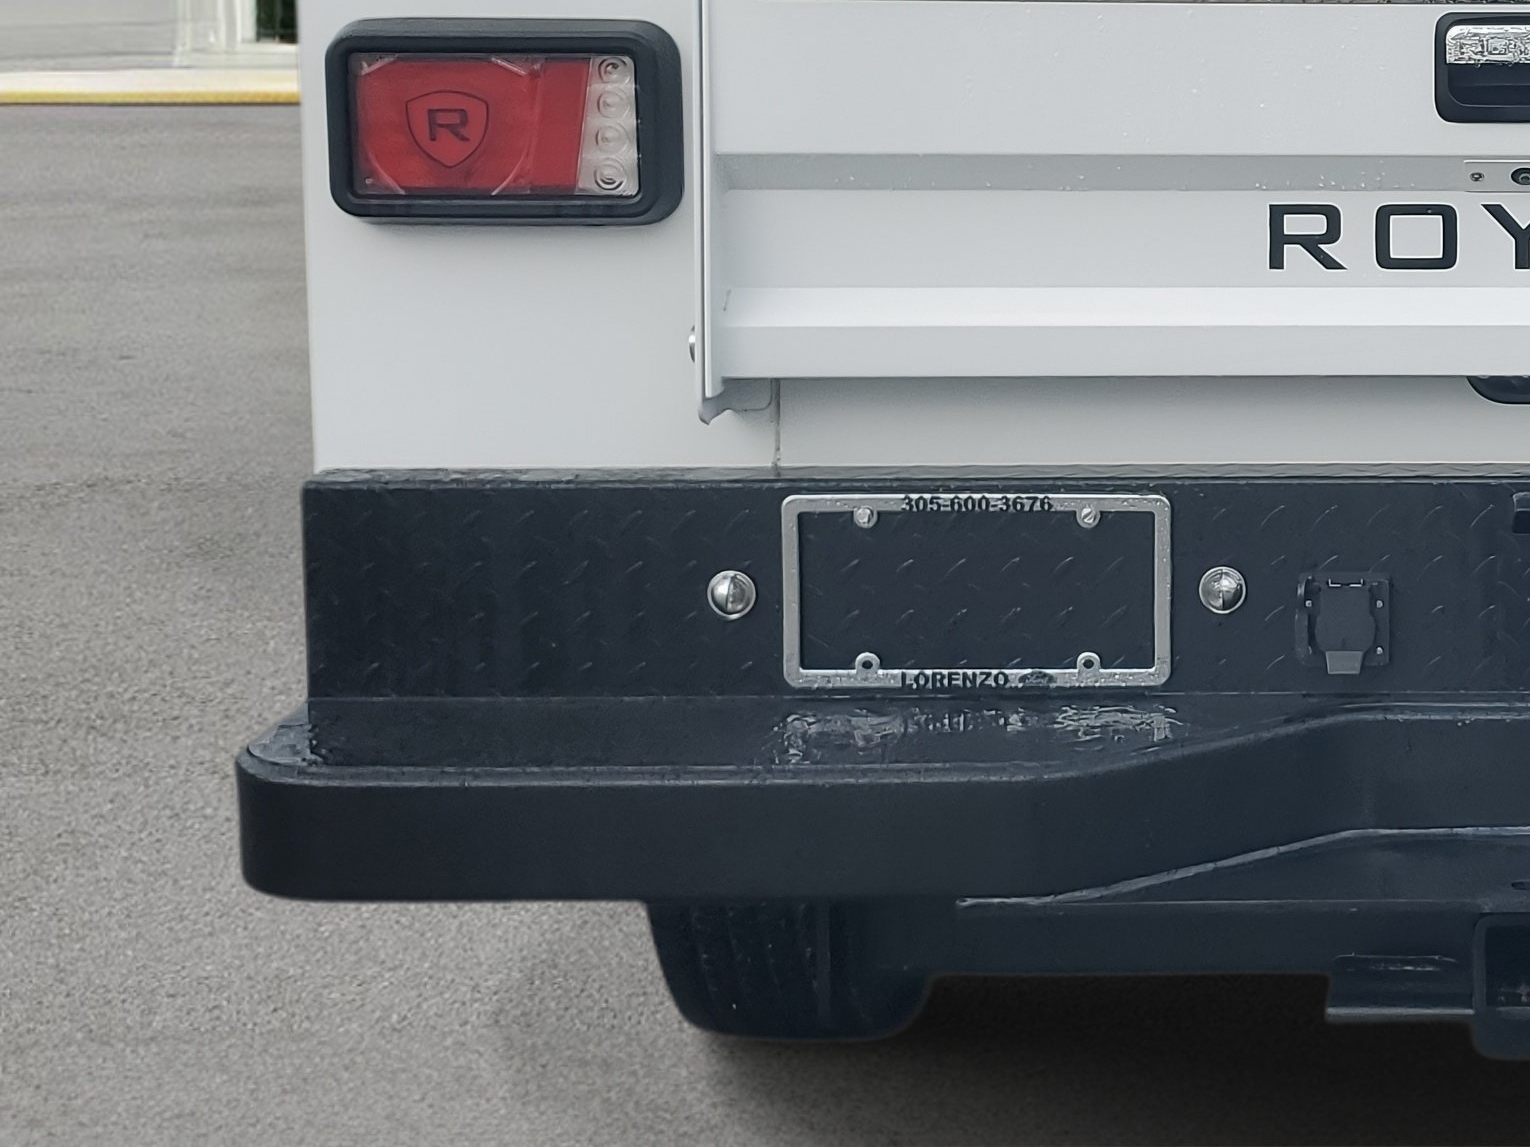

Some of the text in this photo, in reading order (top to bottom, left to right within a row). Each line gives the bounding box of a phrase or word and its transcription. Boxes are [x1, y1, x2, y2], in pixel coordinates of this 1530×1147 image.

[426, 107, 471, 142] R
[901, 494, 1053, 512] 305-600-3676
[900, 670, 1010, 688] LORENZO
